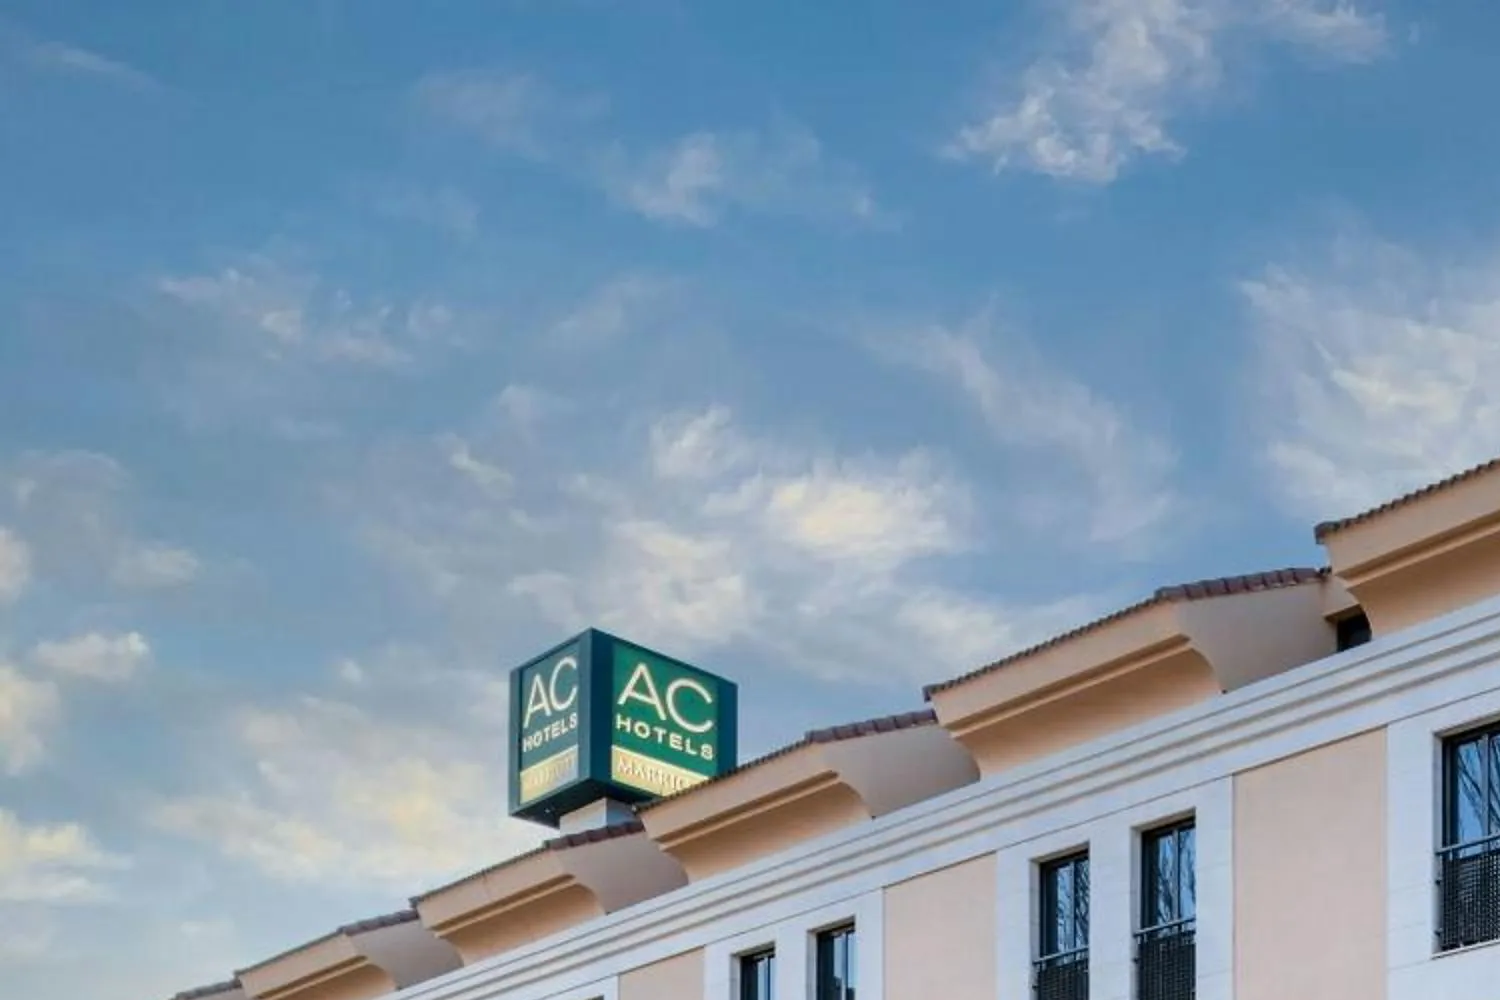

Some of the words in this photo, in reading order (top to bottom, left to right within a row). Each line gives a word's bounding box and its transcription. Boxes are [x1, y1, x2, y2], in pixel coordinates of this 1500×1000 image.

[523, 657, 577, 728] AC
[618, 663, 713, 732] AC
[522, 711, 578, 753] HOTELS
[615, 713, 714, 761] HOTELS
